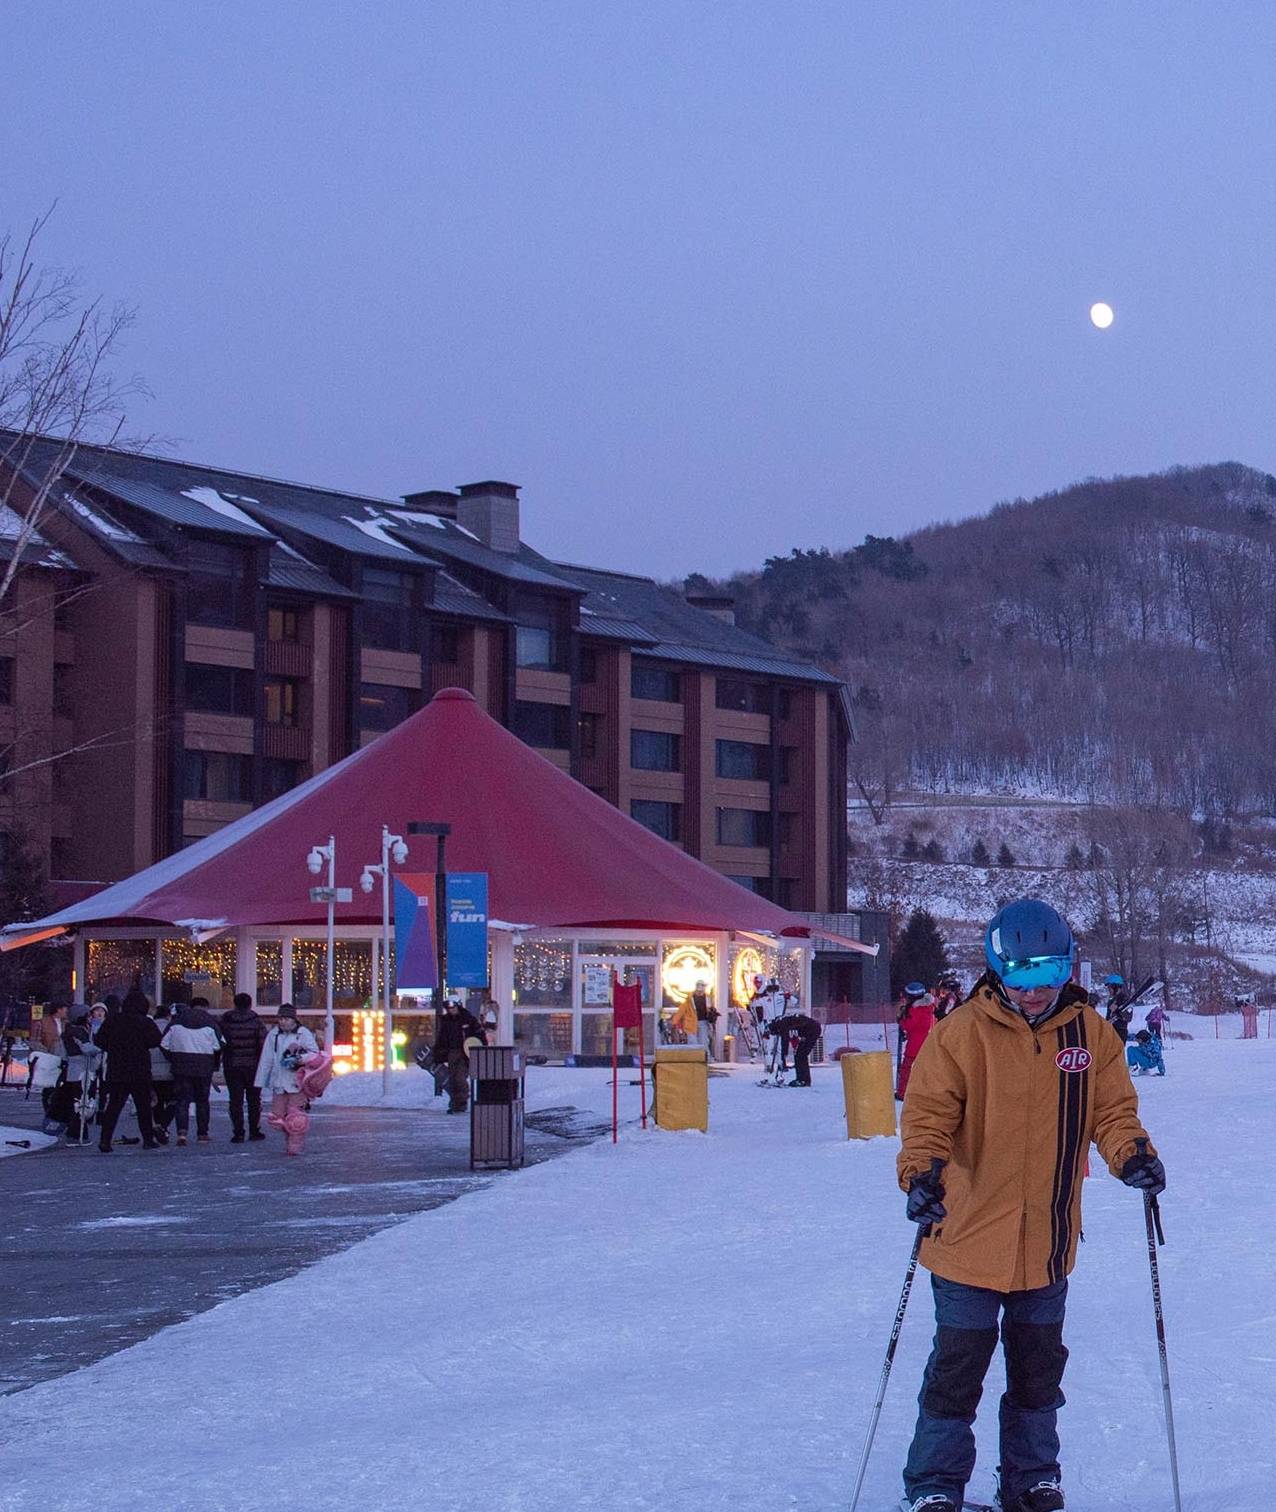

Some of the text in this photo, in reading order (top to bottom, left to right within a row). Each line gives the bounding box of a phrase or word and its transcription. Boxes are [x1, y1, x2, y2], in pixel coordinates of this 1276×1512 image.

[450, 911, 485, 922] fun
[1060, 1050, 1088, 1069] AIR
[892, 1280, 912, 1341] salomon
